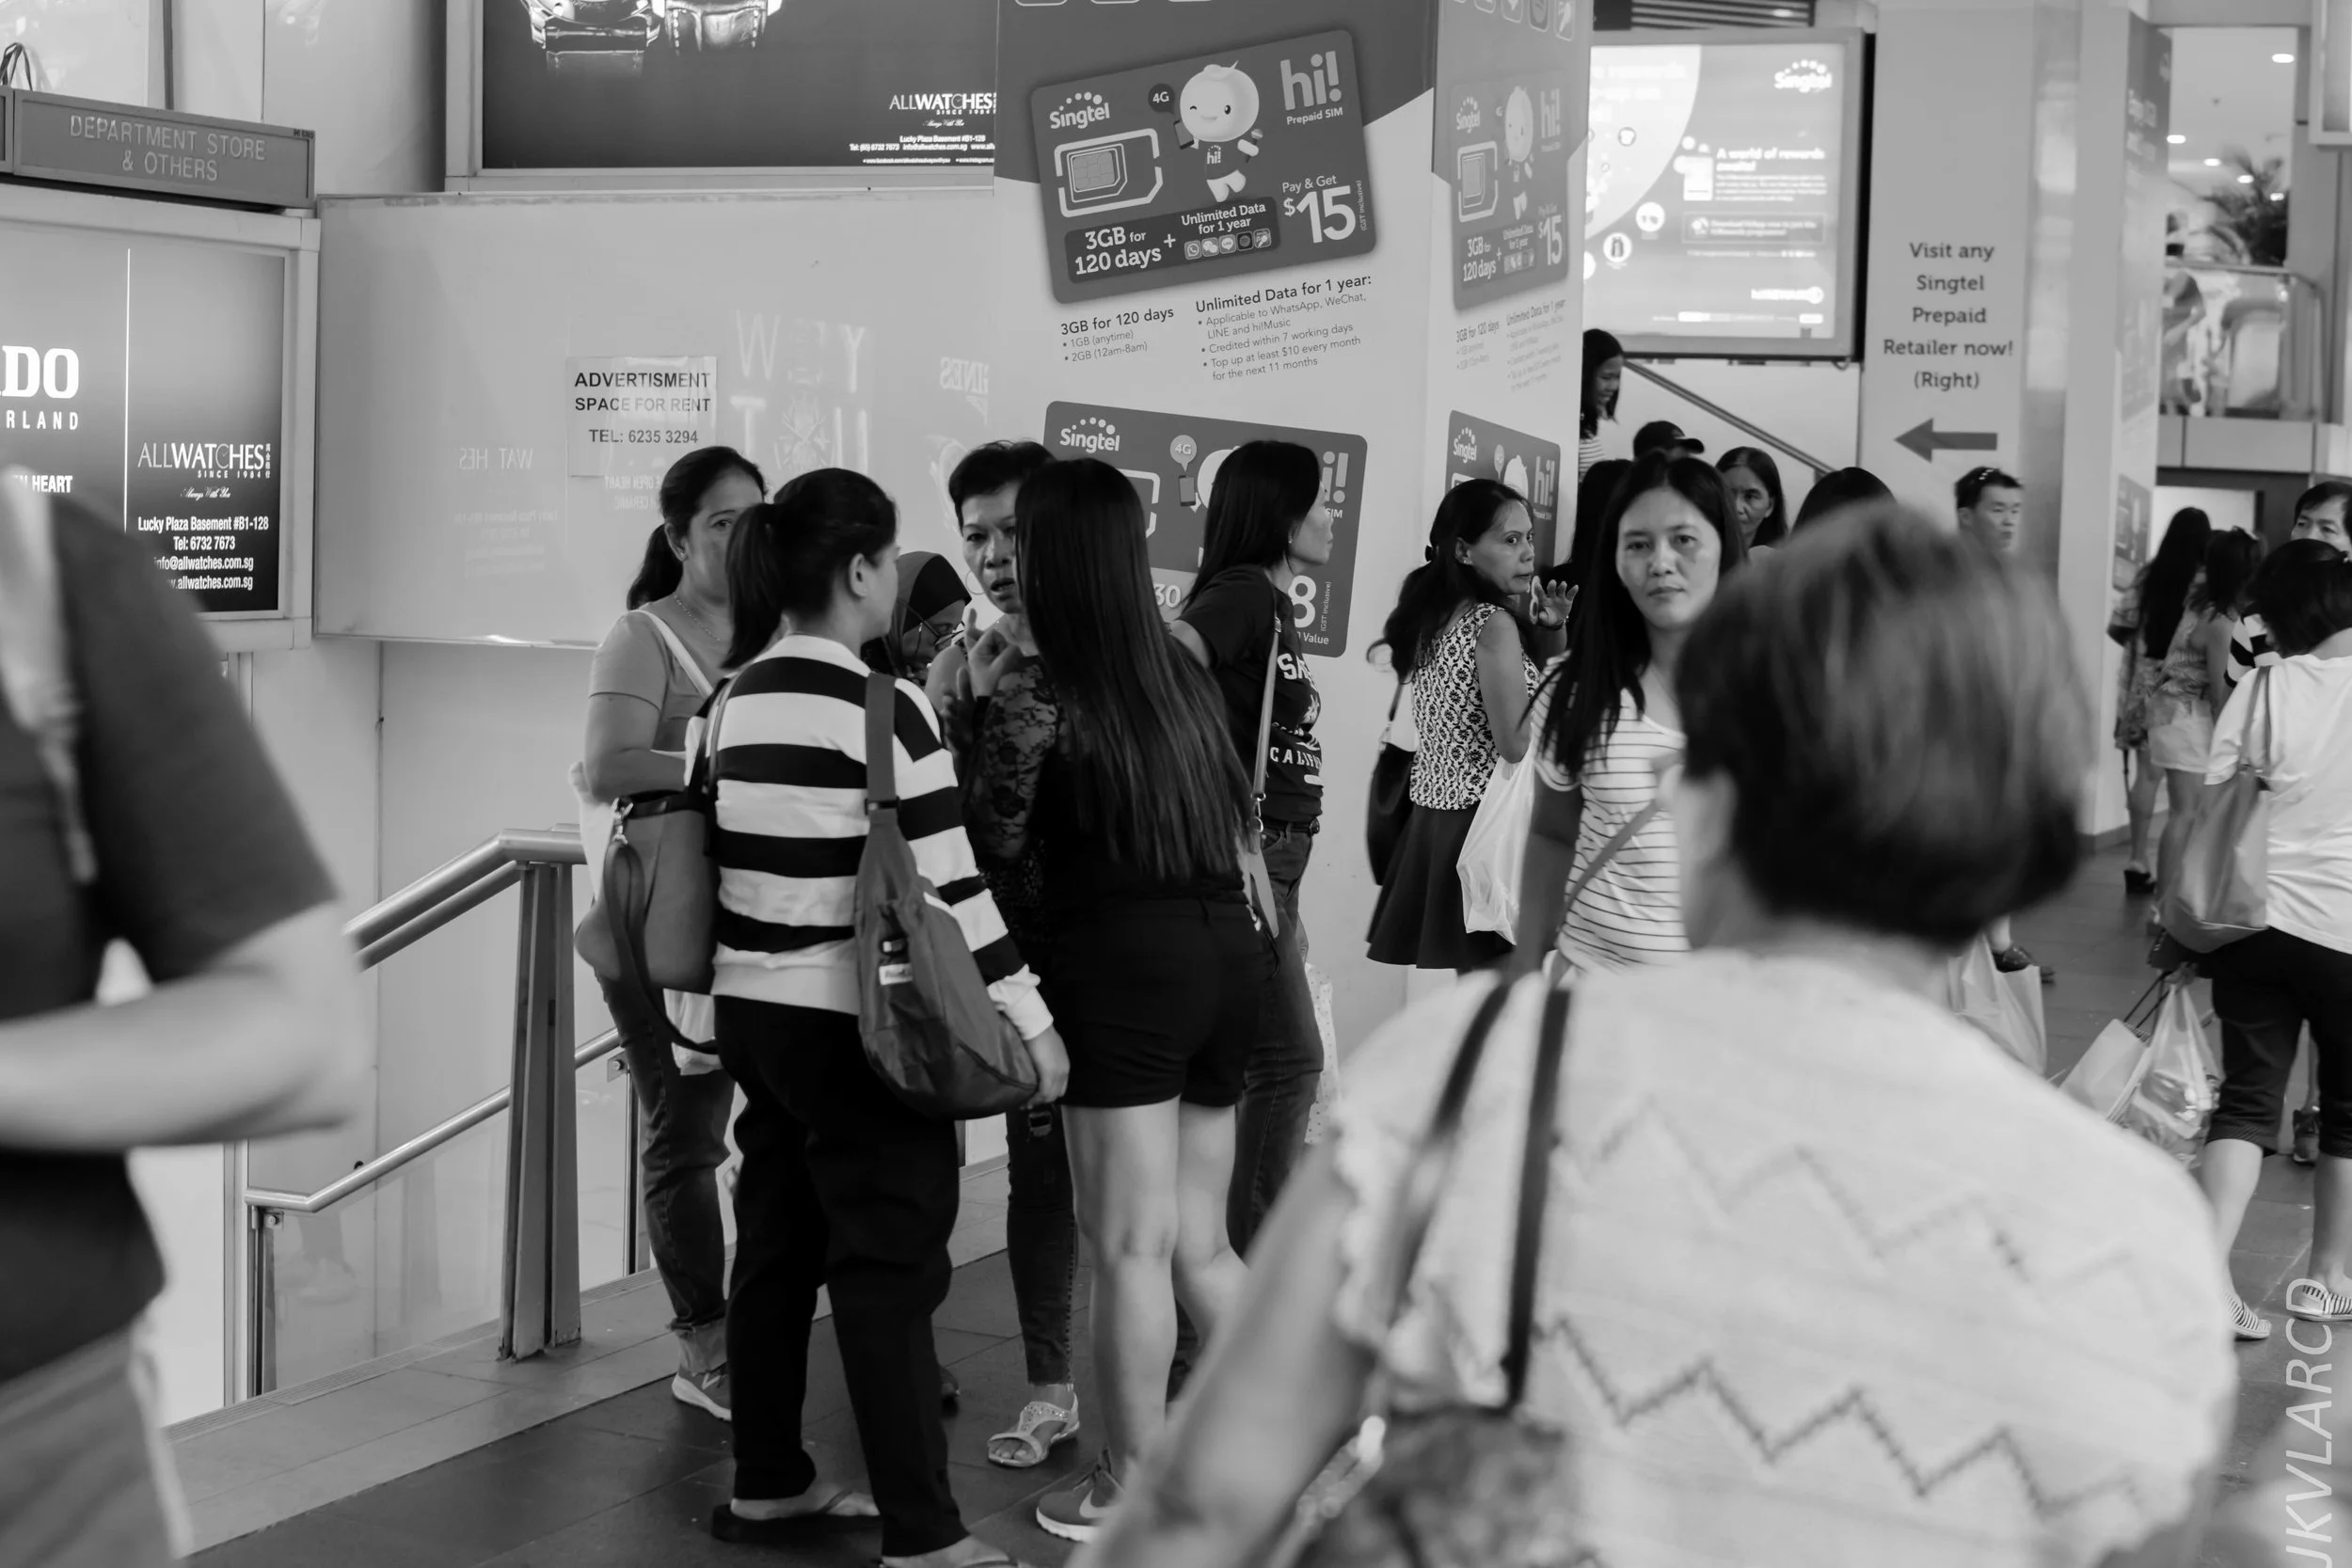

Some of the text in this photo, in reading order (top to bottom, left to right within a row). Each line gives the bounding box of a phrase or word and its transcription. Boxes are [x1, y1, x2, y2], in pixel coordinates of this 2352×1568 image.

[1280, 51, 1342, 111] hi!
[889, 93, 993, 110] ALLWATCHES
[1152, 91, 1169, 103] 4G
[1050, 103, 1110, 129] Singtel
[1286, 106, 1343, 125] Prepaid SIM
[1456, 111, 1481, 134] Singtel
[1540, 87, 1561, 138] hi!
[71, 115, 265, 161] DEPARTMENT STORE
[122, 150, 217, 181] & OTHERS
[1207, 150, 1221, 165] hi!
[1282, 175, 1337, 194] Pay & Get
[1181, 203, 1266, 226] Unlimited Data
[1283, 185, 1356, 244] $15
[1199, 218, 1251, 234] for 1 year
[1085, 227, 1126, 250] 3GB
[1130, 231, 1146, 243] for
[1467, 236, 1484, 257] 3GB
[1075, 247, 1162, 276] 120 days
[1909, 242, 1994, 262] Visit any
[1463, 260, 1497, 282] 120 days
[1196, 276, 1372, 312] Unlimited Data for 1 year:
[1916, 274, 1985, 295] Singtel
[1206, 293, 1367, 327] Applicable to WhatsApp, WeChat,
[1912, 307, 1987, 327] Prepaid
[1060, 309, 1174, 335] 3GB for 120 days
[1208, 326, 1230, 340] LINE
[1232, 324, 1250, 336] and
[1071, 329, 1134, 348] 1GB (anytime)
[1209, 323, 1354, 354] Credited within 7 working days
[1883, 339, 2013, 356] Retailer now!
[1072, 341, 1148, 362] 2GB (12am-8am)
[1211, 336, 1361, 370] Top up at least $10 every month
[0, 345, 79, 399] DO
[1212, 356, 1318, 381] for the next 11 months
[574, 372, 711, 388] ADVERTISMENT
[1914, 371, 1979, 392] (Right)
[575, 397, 710, 412] SPACE FOR RENT
[589, 429, 698, 443] TEL: 6235 3294
[1059, 428, 1120, 453] Singtel
[137, 442, 264, 469] ALLWATCHES
[1175, 444, 1192, 455] 4G
[1453, 437, 1477, 464] Singtel
[32, 475, 73, 493] HEART
[198, 470, 261, 479] SINCE 1984
[1322, 451, 1349, 503] i!
[1534, 455, 1555, 507] hi!
[138, 516, 269, 534] Lucky Plaza Basement #B1-128
[173, 535, 235, 550] Tel: 6732 7673
[1322, 581, 1332, 614] inclusive)
[1303, 632, 1329, 644] Value
